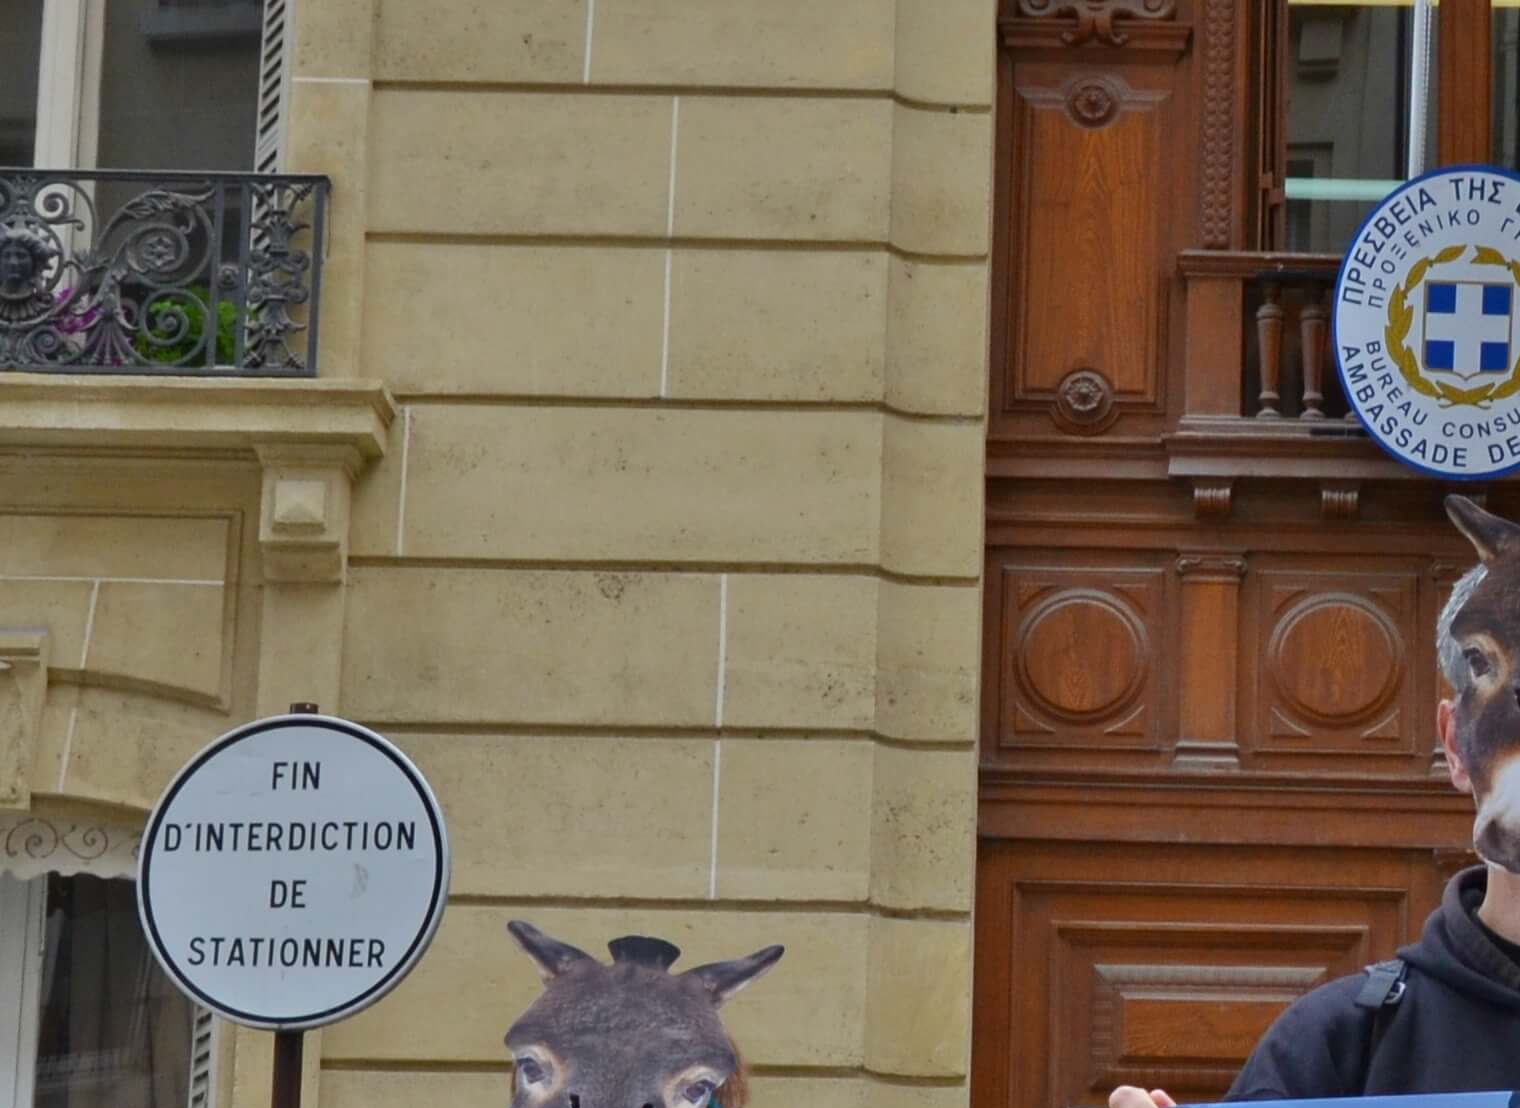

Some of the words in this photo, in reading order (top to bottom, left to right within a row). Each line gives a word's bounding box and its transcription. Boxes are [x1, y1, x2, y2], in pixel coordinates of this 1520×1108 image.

[1343, 187, 1437, 305] ΠΡΕΣΒΕΙΑ
[1450, 178, 1505, 203] ΤΗΣ
[1368, 209, 1480, 308] ΠΡΟΞΕΝΙΚΟ
[1342, 345, 1467, 467] AMBASSADE
[1366, 340, 1429, 426] BUREAU
[272, 762, 321, 790] FIN
[164, 821, 416, 851] D'INTERDICTION
[269, 880, 307, 908] DE
[187, 937, 385, 968] STATIONNER
